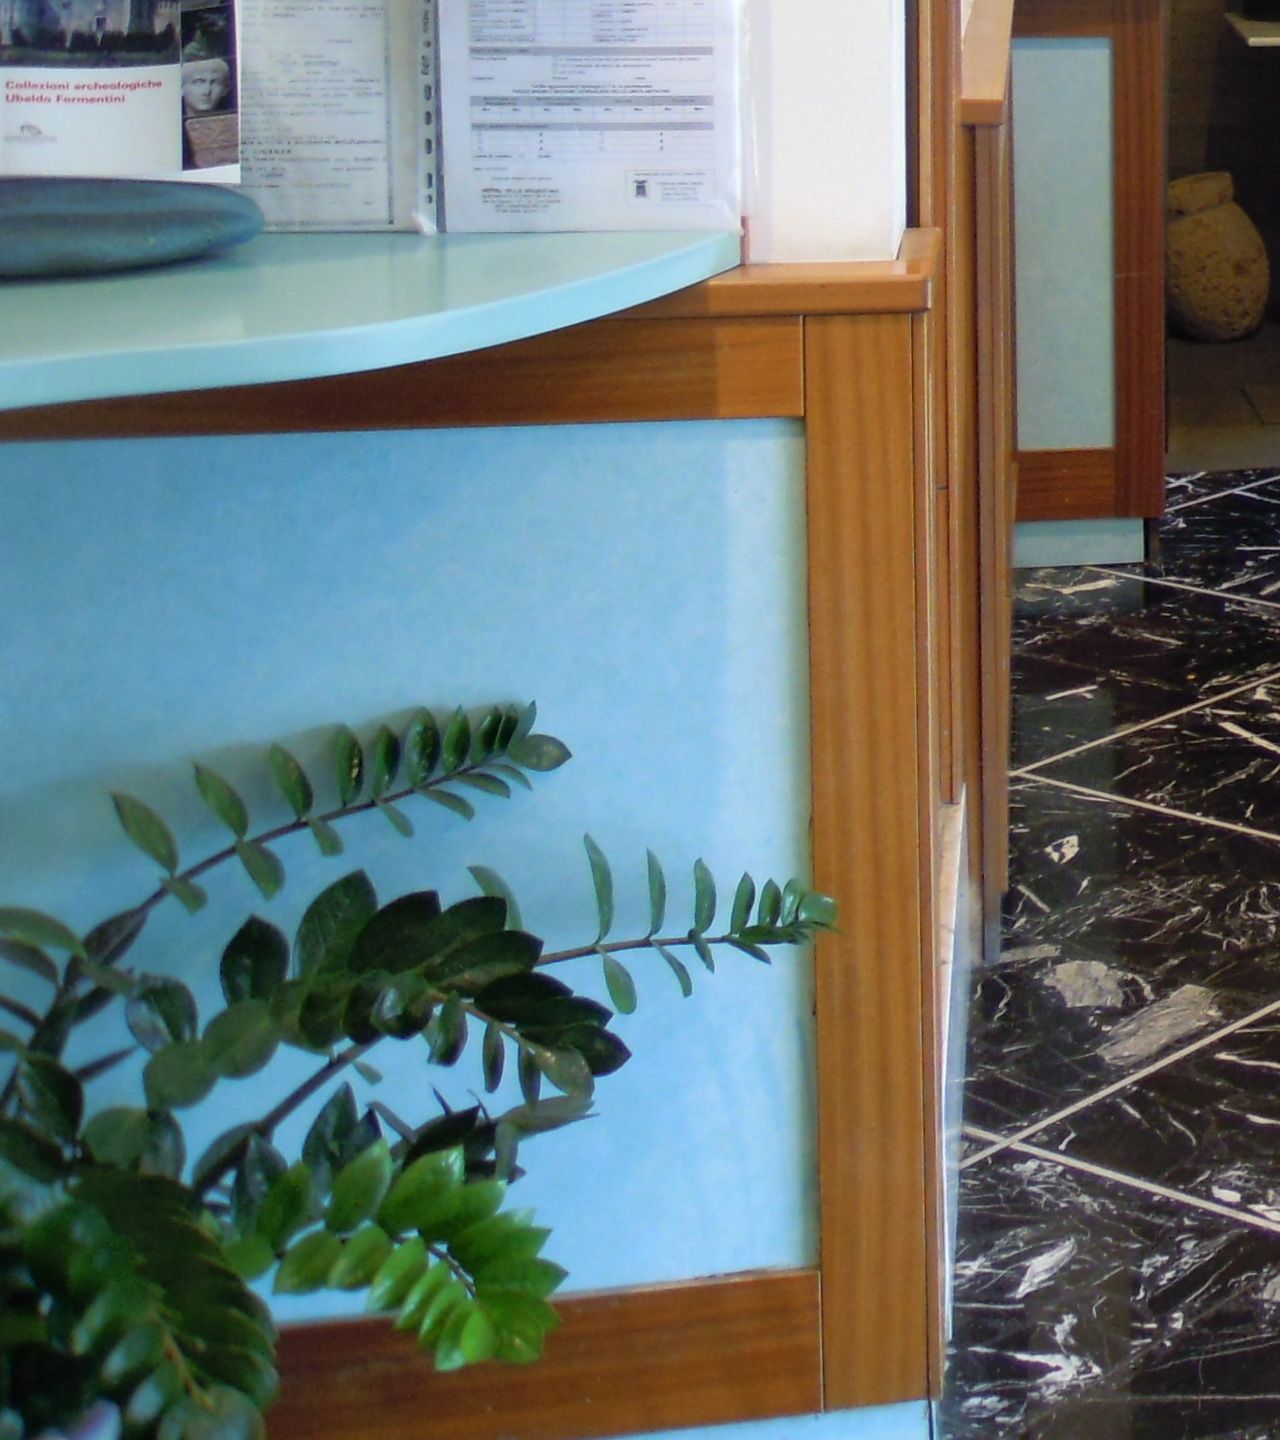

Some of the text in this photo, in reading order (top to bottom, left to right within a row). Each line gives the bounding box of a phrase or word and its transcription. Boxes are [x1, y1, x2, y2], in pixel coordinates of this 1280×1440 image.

[6, 79, 163, 92] Collezioni archeologiche
[5, 94, 125, 104] Ubaldo Formentini
